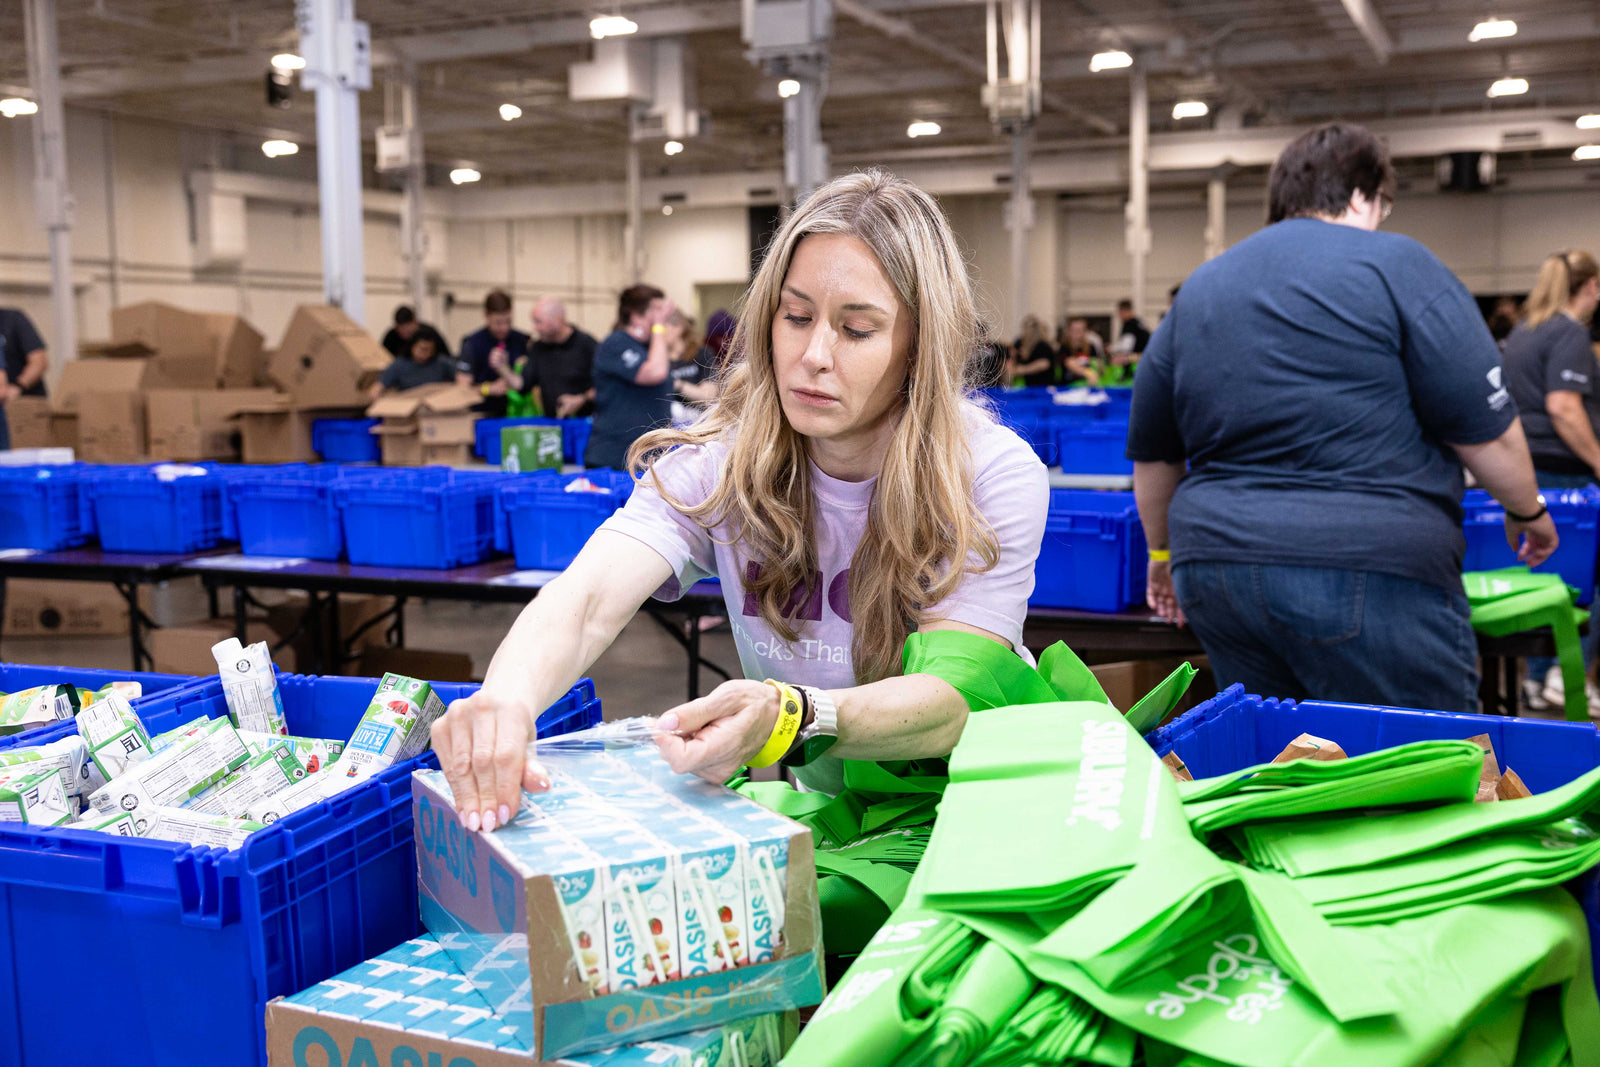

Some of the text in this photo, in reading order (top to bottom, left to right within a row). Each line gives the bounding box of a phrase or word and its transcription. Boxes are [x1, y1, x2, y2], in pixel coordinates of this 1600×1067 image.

[799, 639, 849, 664] That
[354, 728, 377, 745] LAIT
[419, 795, 477, 899] OASIS
[606, 986, 712, 1034] OASIS
